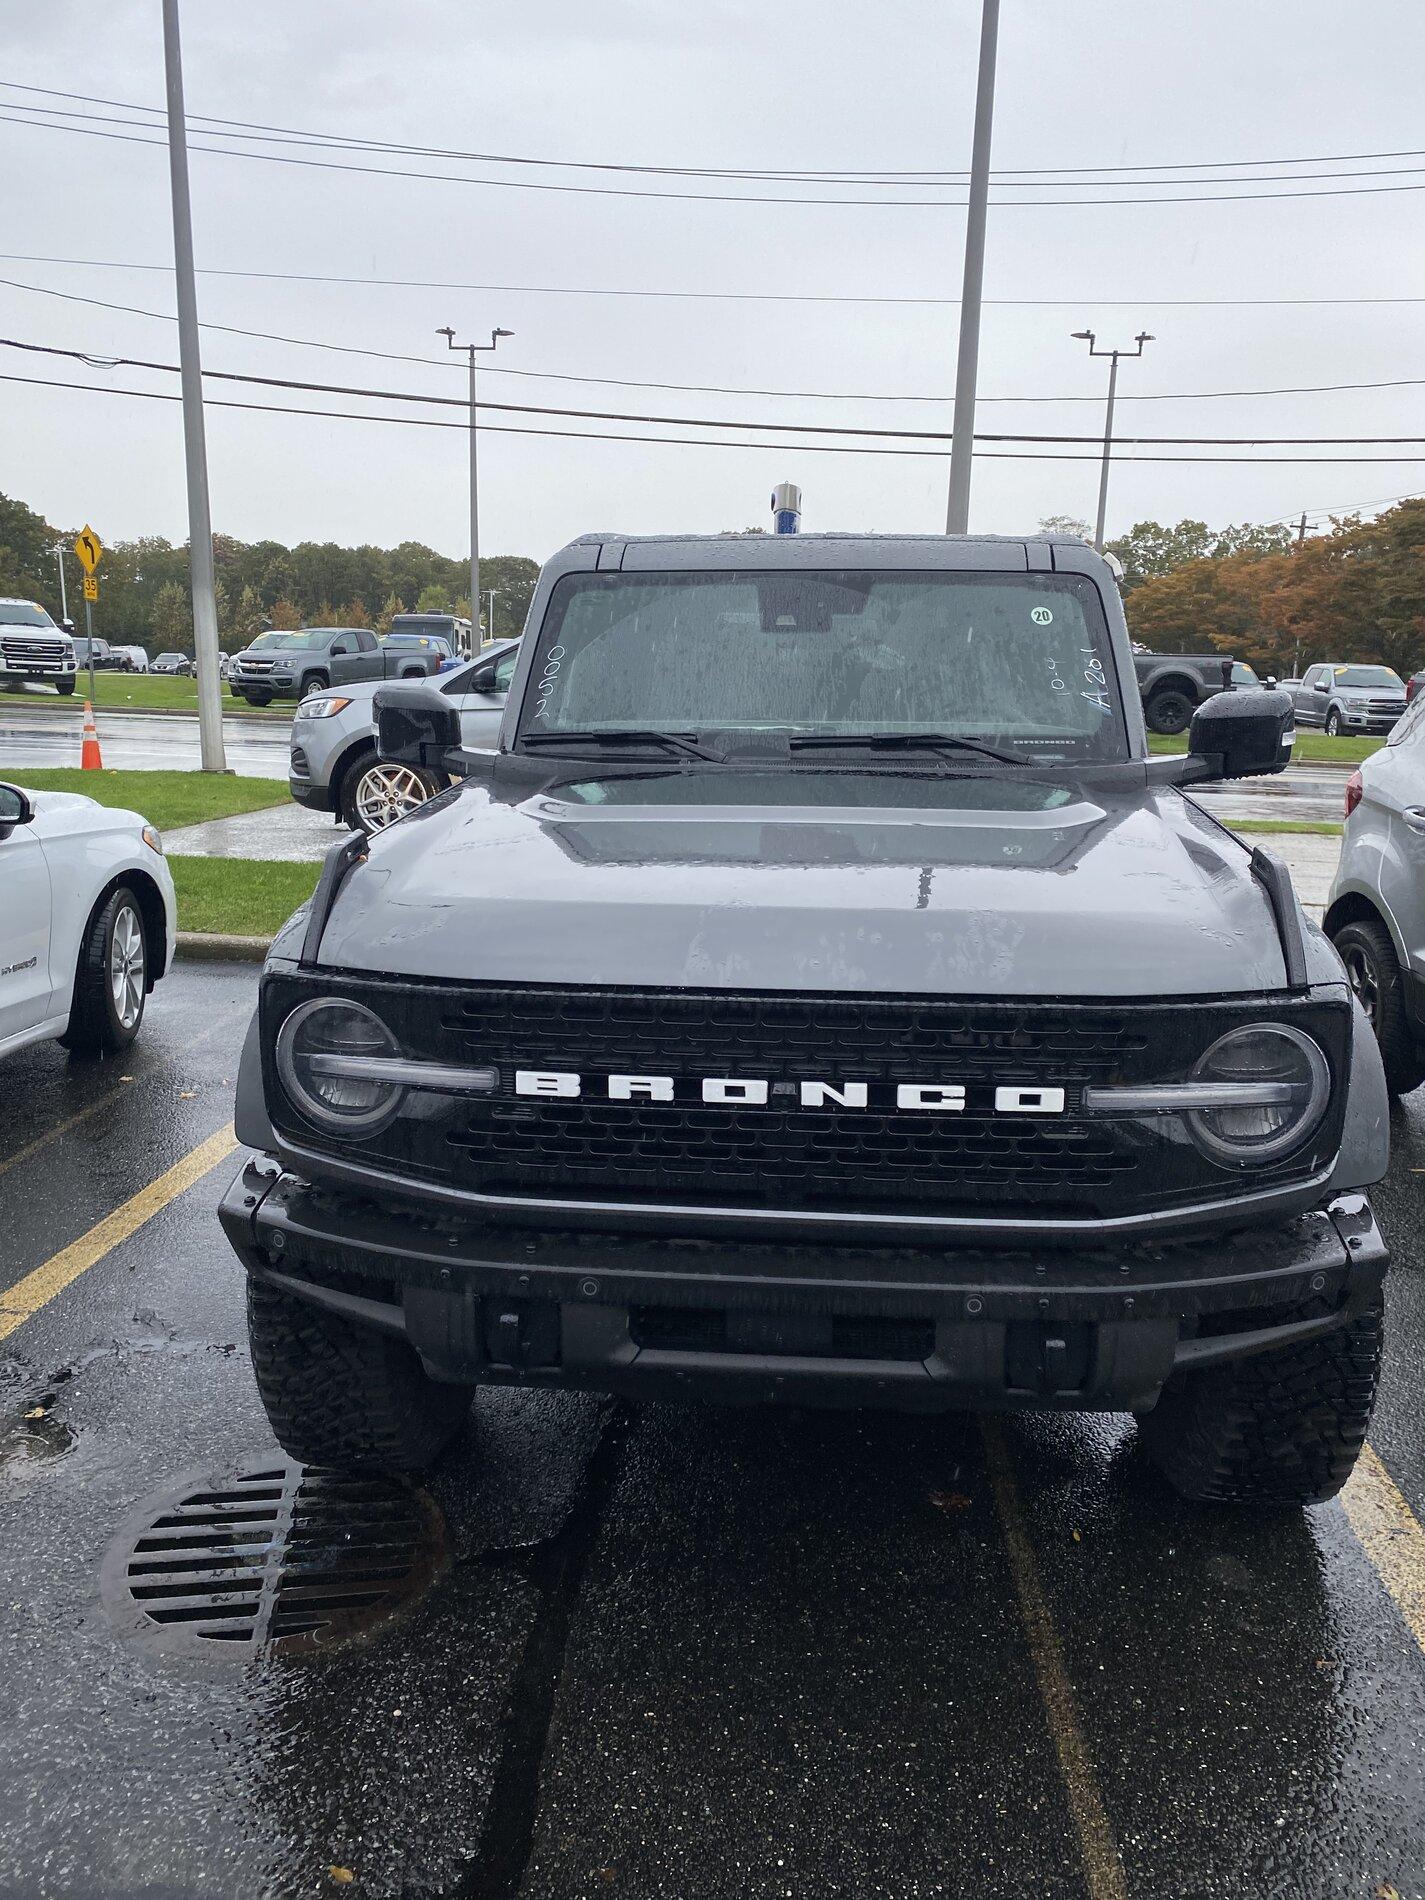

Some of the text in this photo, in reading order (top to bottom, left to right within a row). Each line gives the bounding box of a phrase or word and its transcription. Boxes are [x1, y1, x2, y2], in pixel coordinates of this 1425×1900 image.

[85, 579, 97, 591] 35
[1034, 610, 1050, 622] 20
[515, 1069, 1065, 1113] BRONCO
